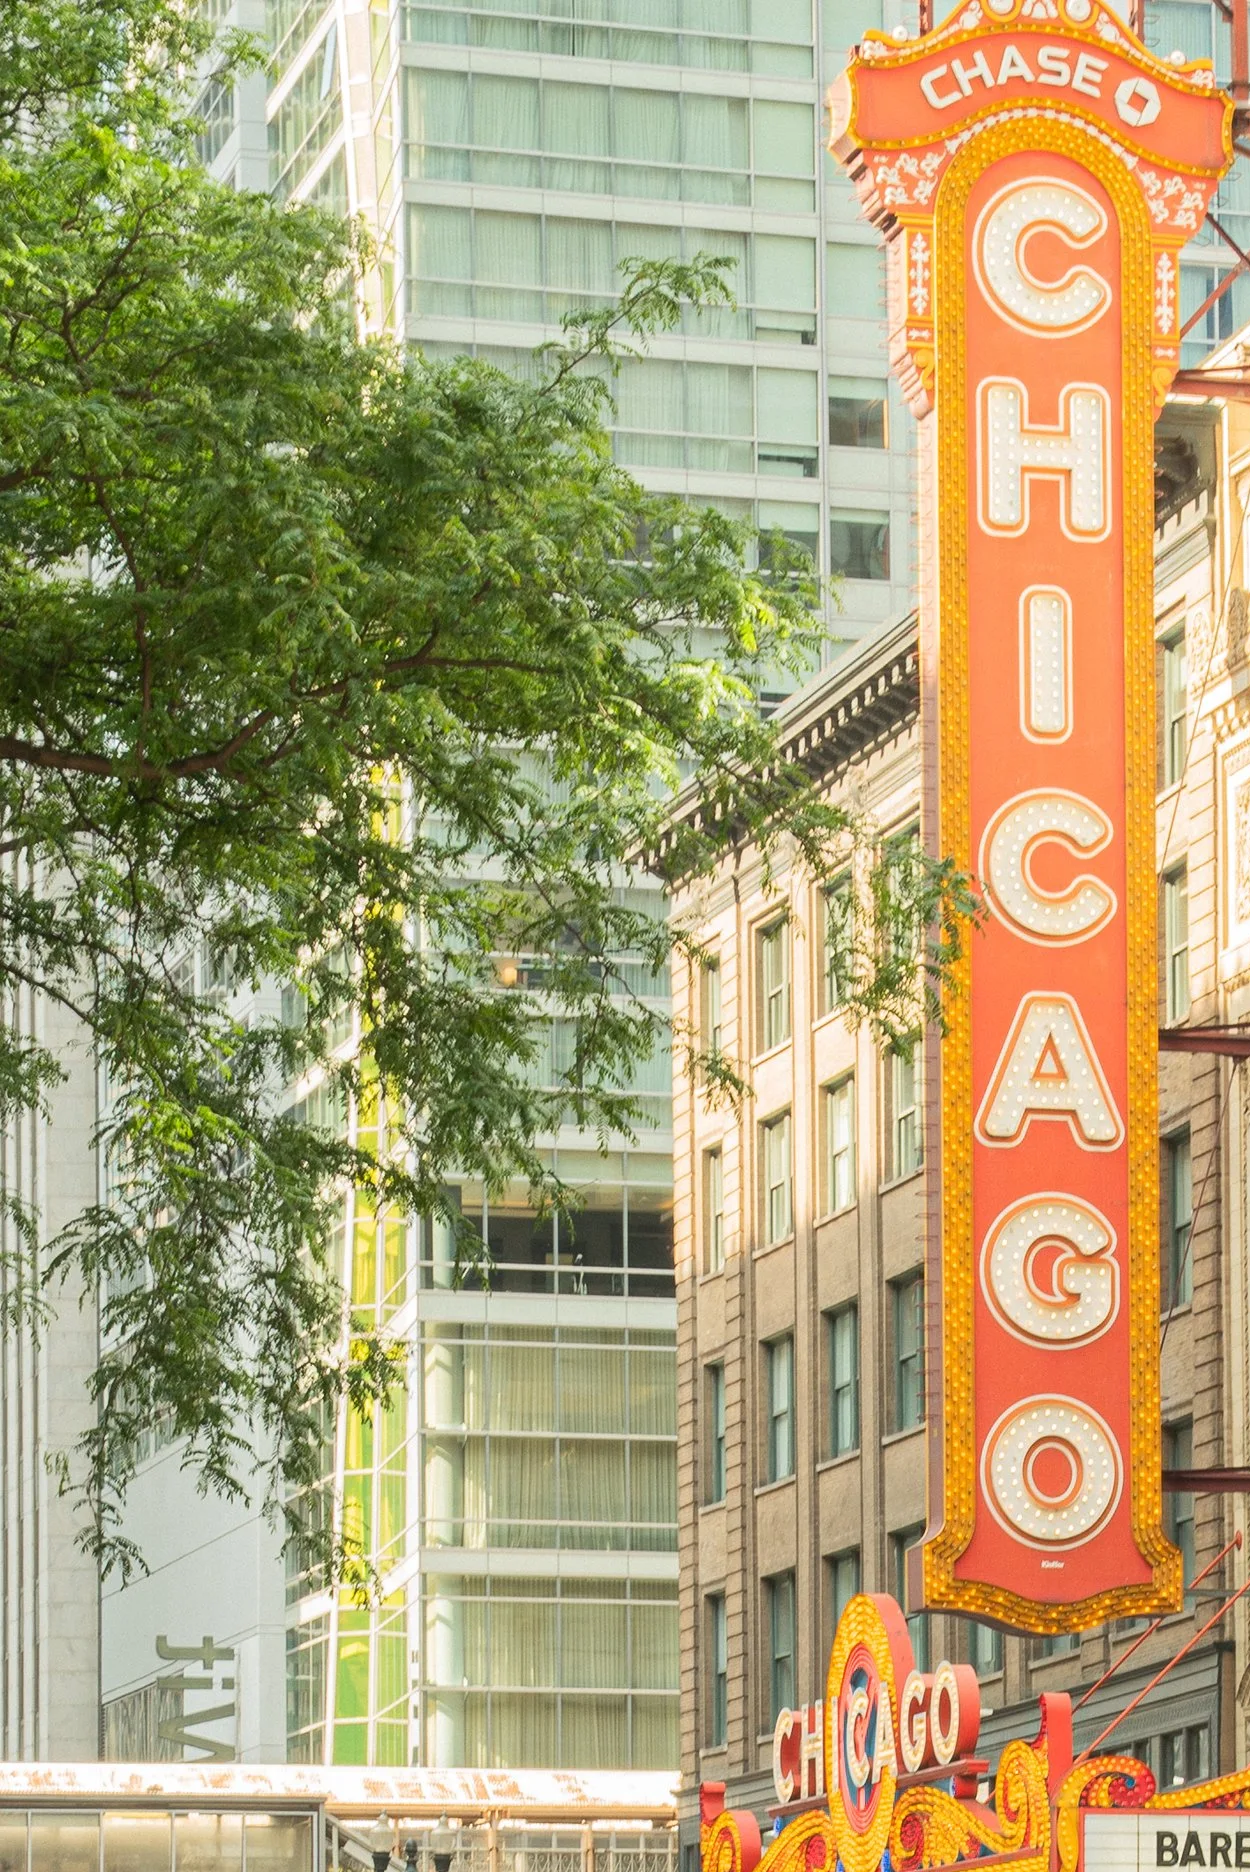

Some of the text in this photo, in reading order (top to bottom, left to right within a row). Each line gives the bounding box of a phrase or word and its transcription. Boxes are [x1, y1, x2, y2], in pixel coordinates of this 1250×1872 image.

[920, 44, 1110, 110] CHASE
[972, 177, 1126, 1552] CHICAGO
[773, 1660, 960, 1804] CHICAGO
